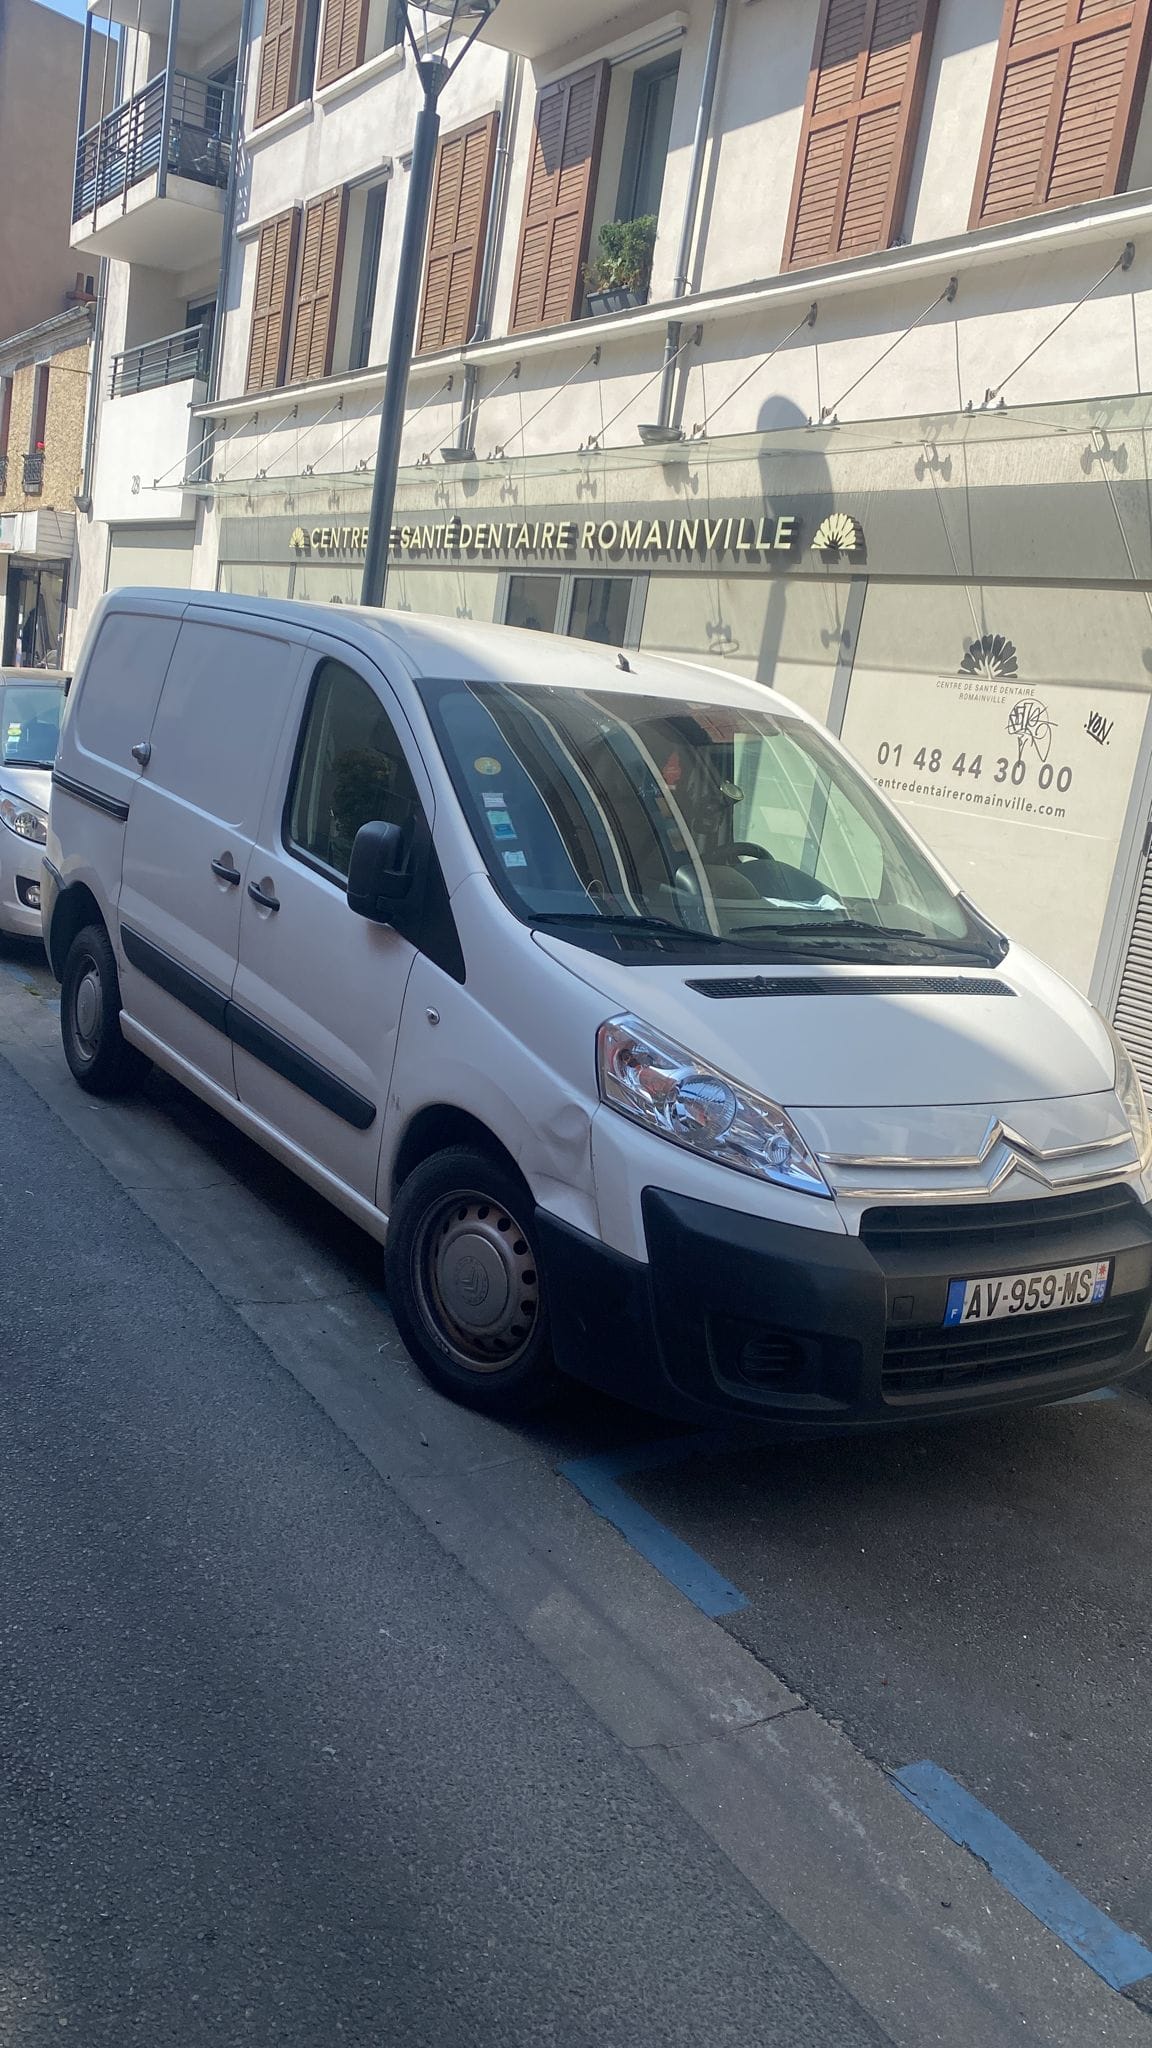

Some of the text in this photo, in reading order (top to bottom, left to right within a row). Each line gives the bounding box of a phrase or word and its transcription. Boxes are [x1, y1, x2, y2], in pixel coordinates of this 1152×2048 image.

[310, 527, 368, 549] CENTRE
[400, 516, 456, 549] SANTÉ
[460, 522, 571, 549] DENTAIRE
[581, 516, 796, 550] ROMAINVILLE
[936, 680, 1035, 697] CENTRE DE SANTÉ DENTAIRE
[959, 692, 1006, 704] ROMAINVILLE
[877, 741, 1073, 793] 01 48 44 30 00
[950, 1269, 1105, 1320] F AV-959-MS 75
